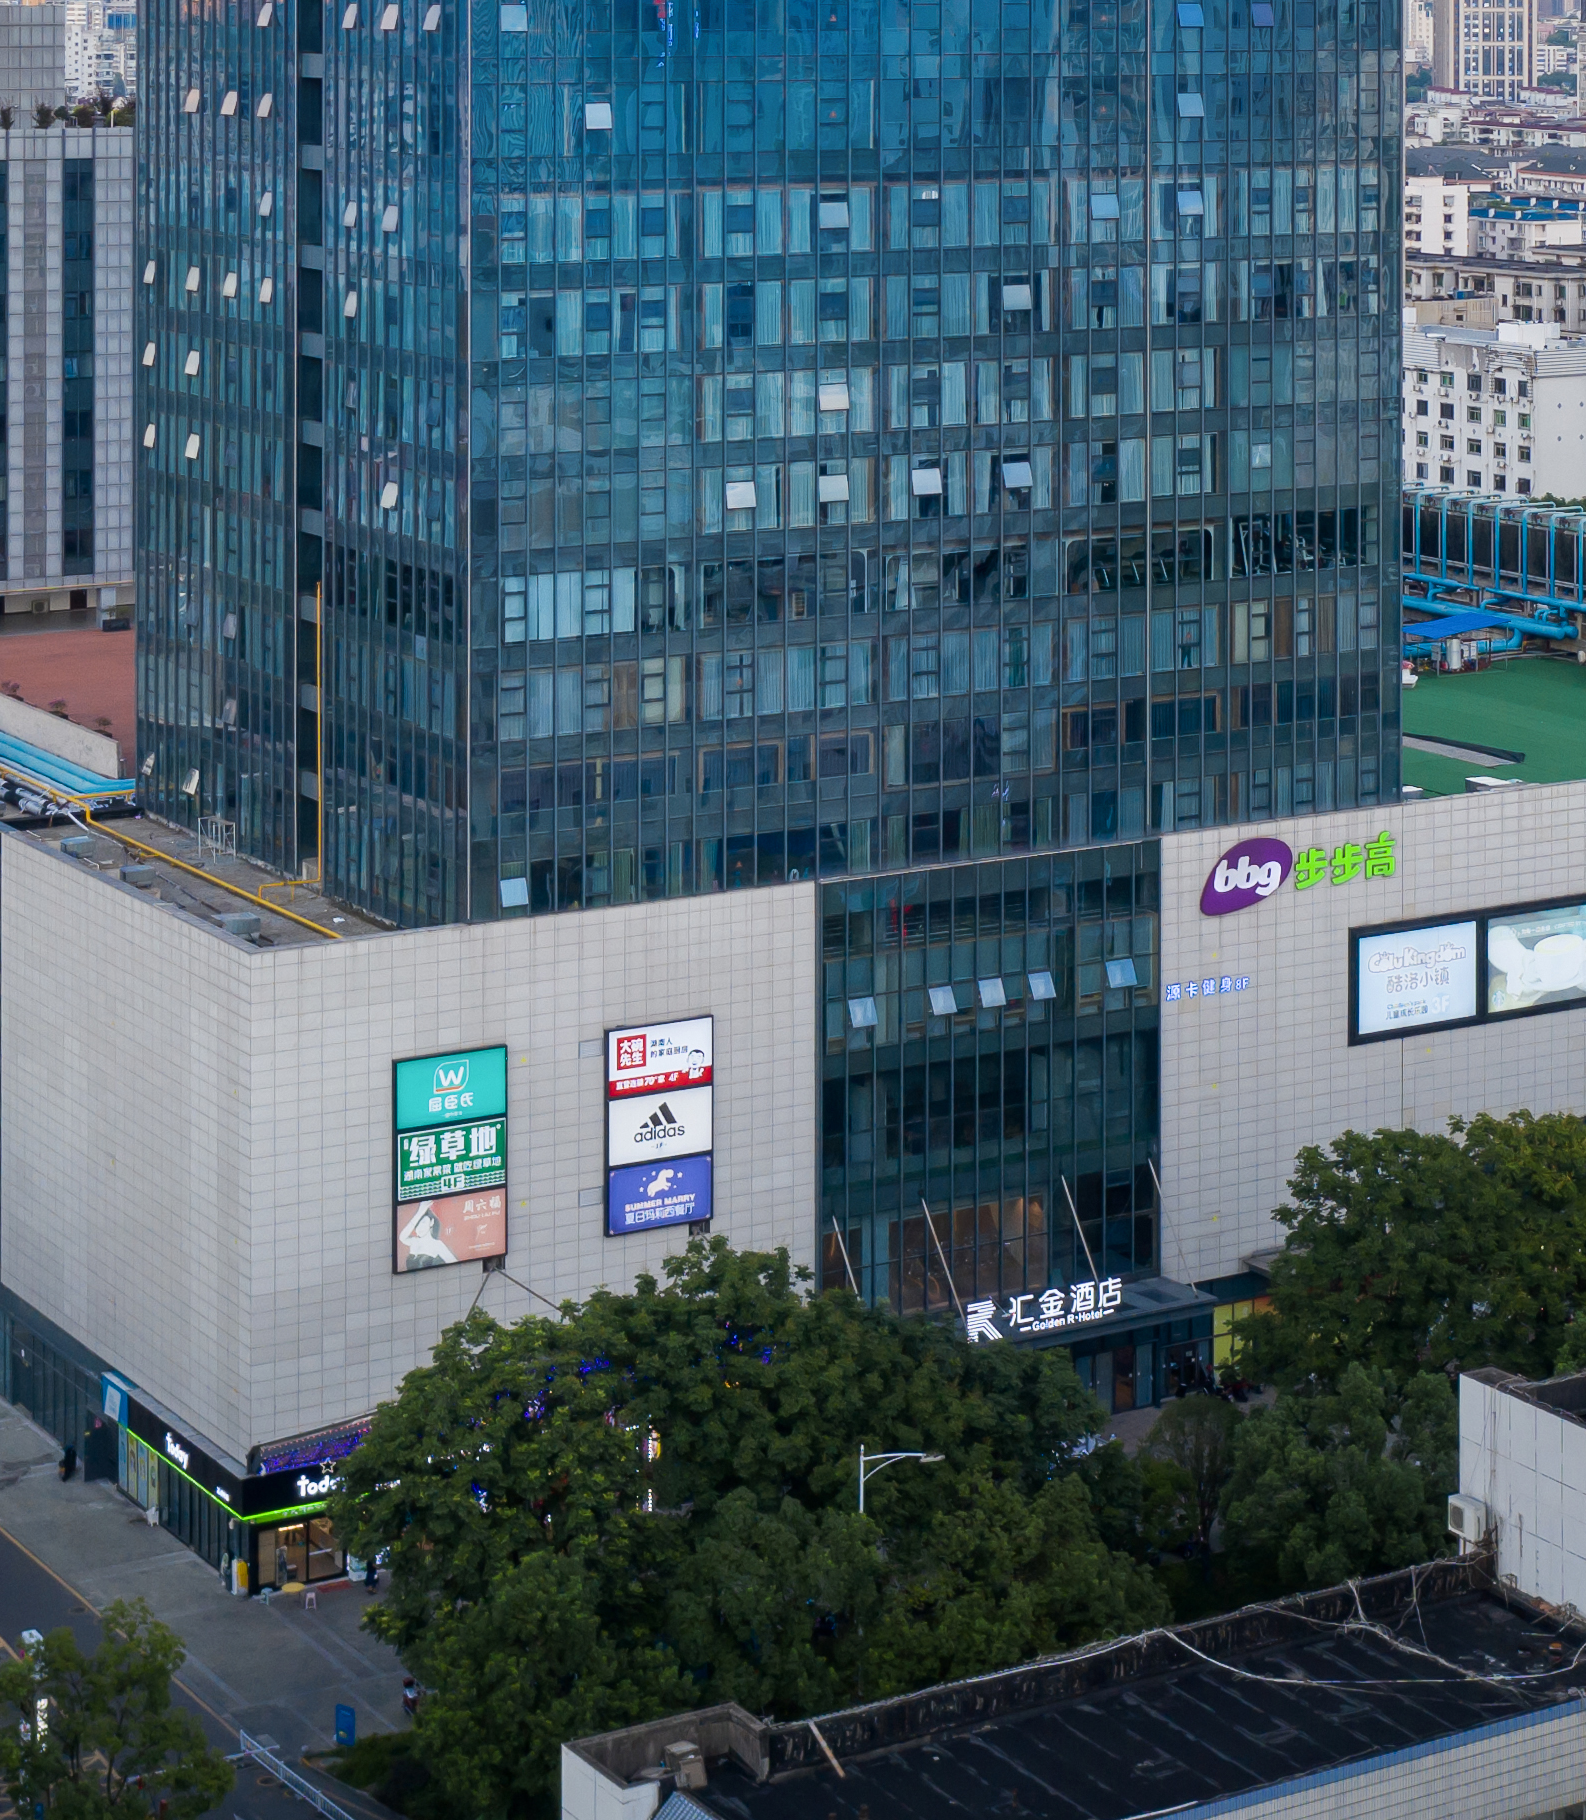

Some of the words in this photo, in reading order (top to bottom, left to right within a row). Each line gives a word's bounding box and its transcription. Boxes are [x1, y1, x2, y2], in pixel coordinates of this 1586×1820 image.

[1295, 831, 1397, 890] 步步高
[1213, 856, 1281, 896] bbg
[1386, 966, 1450, 994] 酷洛小镇
[1386, 1005, 1429, 1020] 儿童成长乐园
[1431, 994, 1450, 1015] 3F
[619, 1051, 644, 1068] 先生
[428, 1092, 474, 1113] 屈臣氏
[633, 1125, 685, 1143] adidas
[408, 1125, 497, 1167] 绿草地
[463, 1195, 502, 1214] 周六福
[624, 1198, 663, 1213] SUMMER
[664, 1193, 695, 1206] MARRY
[1009, 1277, 1123, 1327] 汇金酒店
[1031, 1316, 1066, 1332] Golden
